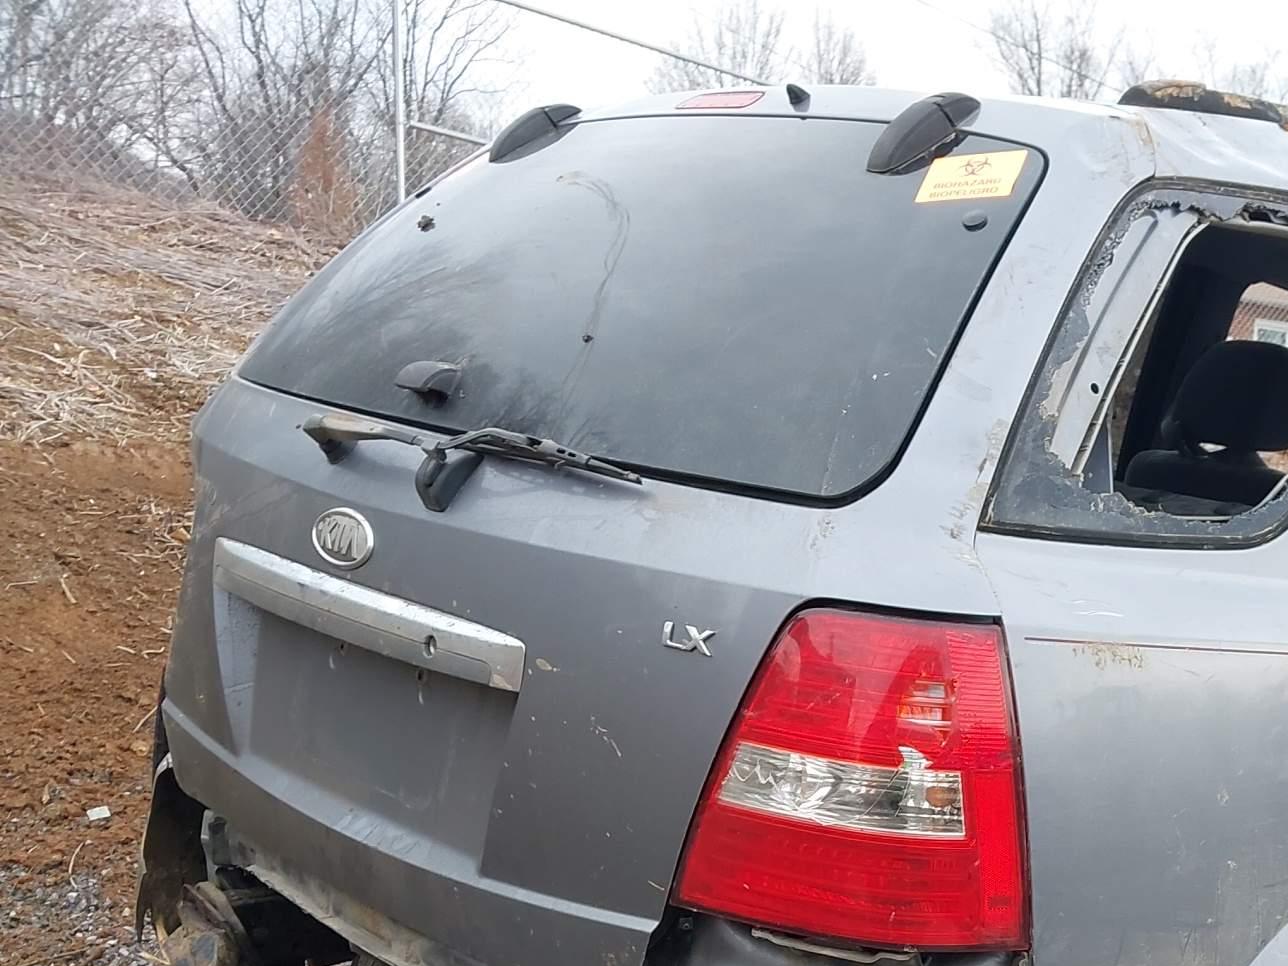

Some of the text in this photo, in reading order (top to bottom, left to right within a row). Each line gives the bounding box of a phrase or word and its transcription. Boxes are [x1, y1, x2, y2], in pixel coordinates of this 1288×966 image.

[928, 186, 999, 199] BIOPELIGRO
[933, 177, 1002, 189] BIOHAZARD
[316, 514, 366, 559] KIA
[661, 620, 716, 657] LX
